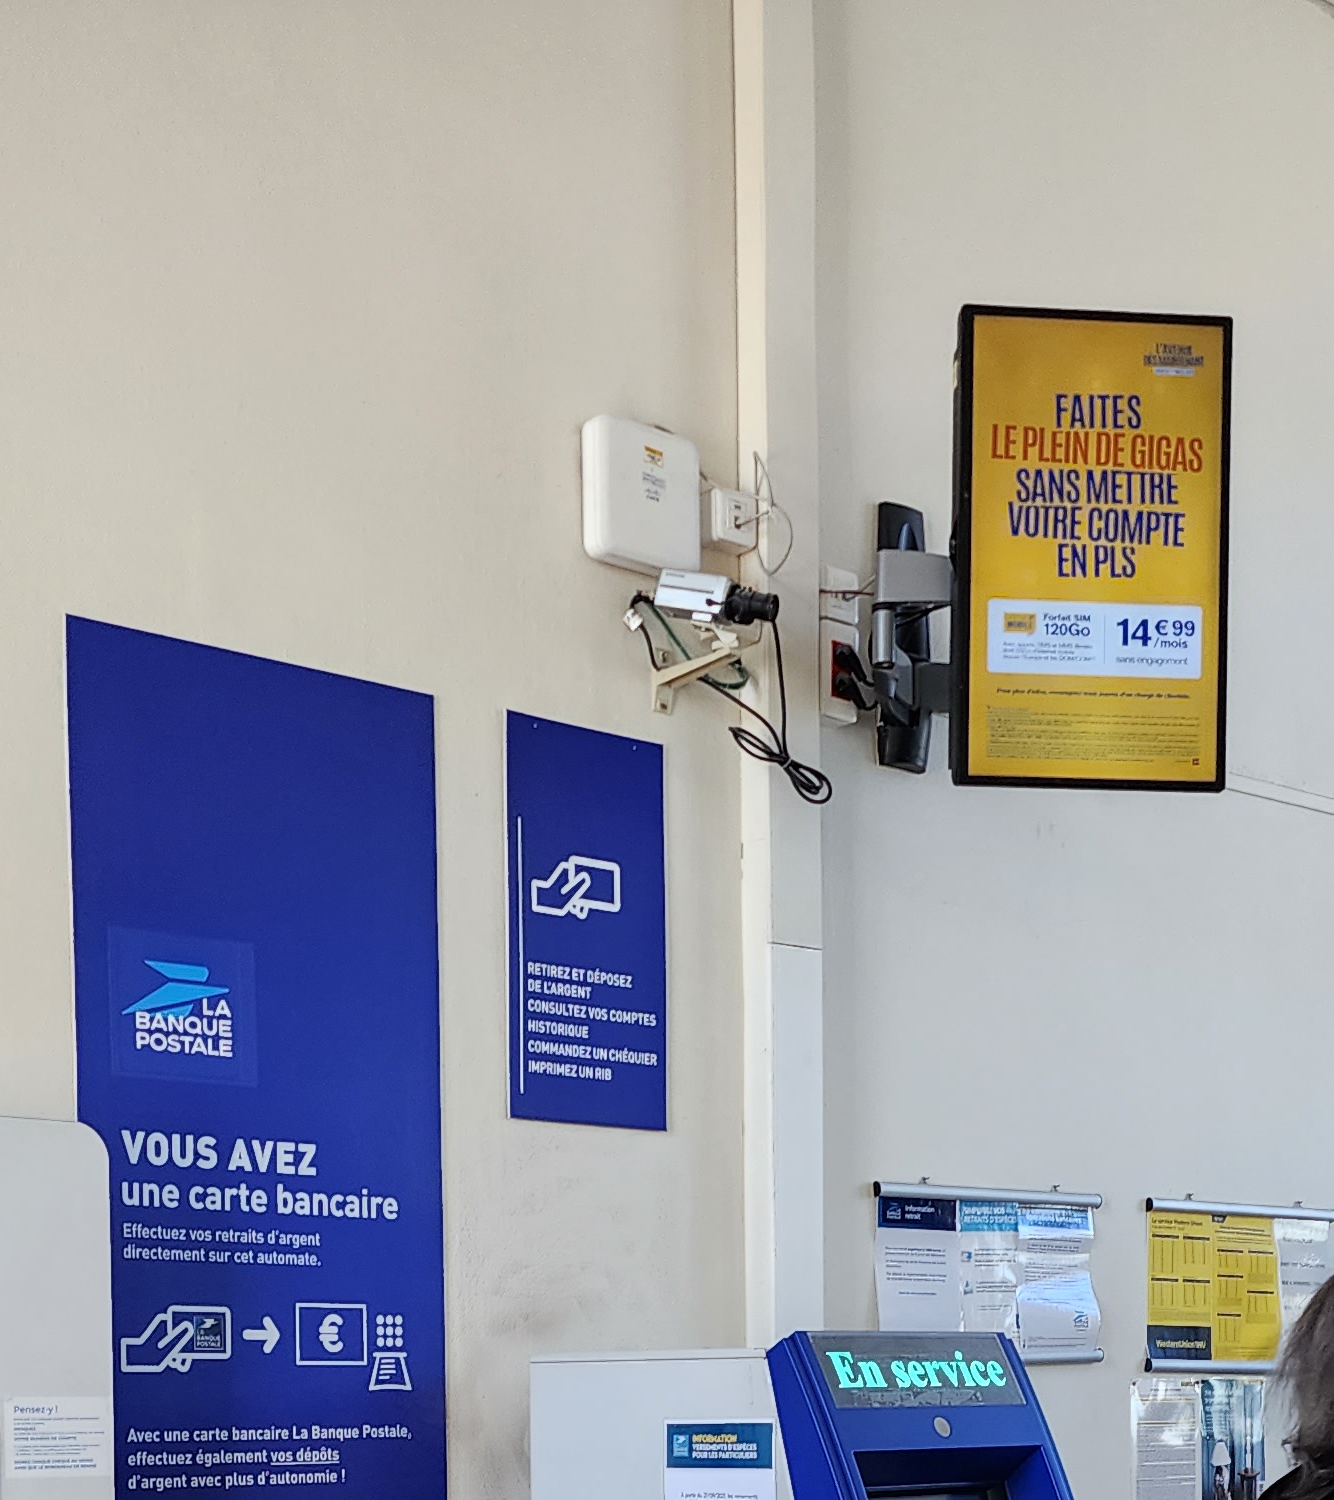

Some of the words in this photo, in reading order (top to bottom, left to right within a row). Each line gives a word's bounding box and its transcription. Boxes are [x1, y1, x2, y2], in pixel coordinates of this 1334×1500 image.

[1055, 393, 1142, 430] FAITES
[990, 423, 1017, 461] LE
[1022, 426, 1089, 465] PLEIN
[1095, 431, 1126, 468] DE
[1130, 433, 1204, 473] GIGAS
[1016, 467, 1081, 504] SANS
[1085, 469, 1179, 505] METTRE
[1007, 501, 1082, 540] VOTRE
[1087, 506, 1186, 548] COMPTE
[1057, 543, 1087, 578] EN
[1093, 543, 1137, 579] PLS
[1043, 622, 1091, 637] 120Go
[527, 961, 571, 979] RETIREZ
[571, 967, 586, 982] ET
[586, 967, 633, 989] DÉPOSEZ
[527, 978, 542, 993] DE
[543, 981, 592, 1000] L'ARGENT
[201, 997, 232, 1018] LA
[527, 998, 587, 1019] CONSULTEZ
[588, 1006, 608, 1022] VOS
[609, 1009, 657, 1027] COMPTES
[135, 1011, 233, 1038] BANQUE
[527, 1018, 589, 1039] HISTORIQUE
[135, 1031, 233, 1058] POSTALE
[527, 1039, 592, 1060] COMMANDEZ
[592, 1047, 608, 1061] UN
[608, 1047, 658, 1067] CHÉQUIER
[528, 1060, 578, 1078] IMPRIMEZ
[578, 1065, 594, 1080] UN
[594, 1067, 613, 1081] RIB
[120, 1129, 219, 1170] VOUS
[227, 1138, 318, 1177] AVEZ
[121, 1180, 181, 1209] une
[188, 1183, 268, 1214] carte
[276, 1183, 400, 1221] bancaire
[122, 1222, 187, 1242] Effectuez
[188, 1228, 213, 1243] vos
[215, 1228, 265, 1245] retraits
[267, 1230, 321, 1249] d'argent
[123, 1244, 206, 1263] directement
[208, 1251, 231, 1265] sur
[233, 1250, 255, 1265] cet
[257, 1251, 323, 1267] automate.
[825, 1350, 888, 1389] En
[889, 1349, 1008, 1389] service
[127, 1428, 161, 1444] Avec
[163, 1430, 190, 1443] une
[193, 1428, 229, 1442] carte
[232, 1425, 290, 1441] bancaire
[292, 1426, 309, 1440] La
[312, 1426, 360, 1442] Banque
[362, 1424, 413, 1441] Postale,
